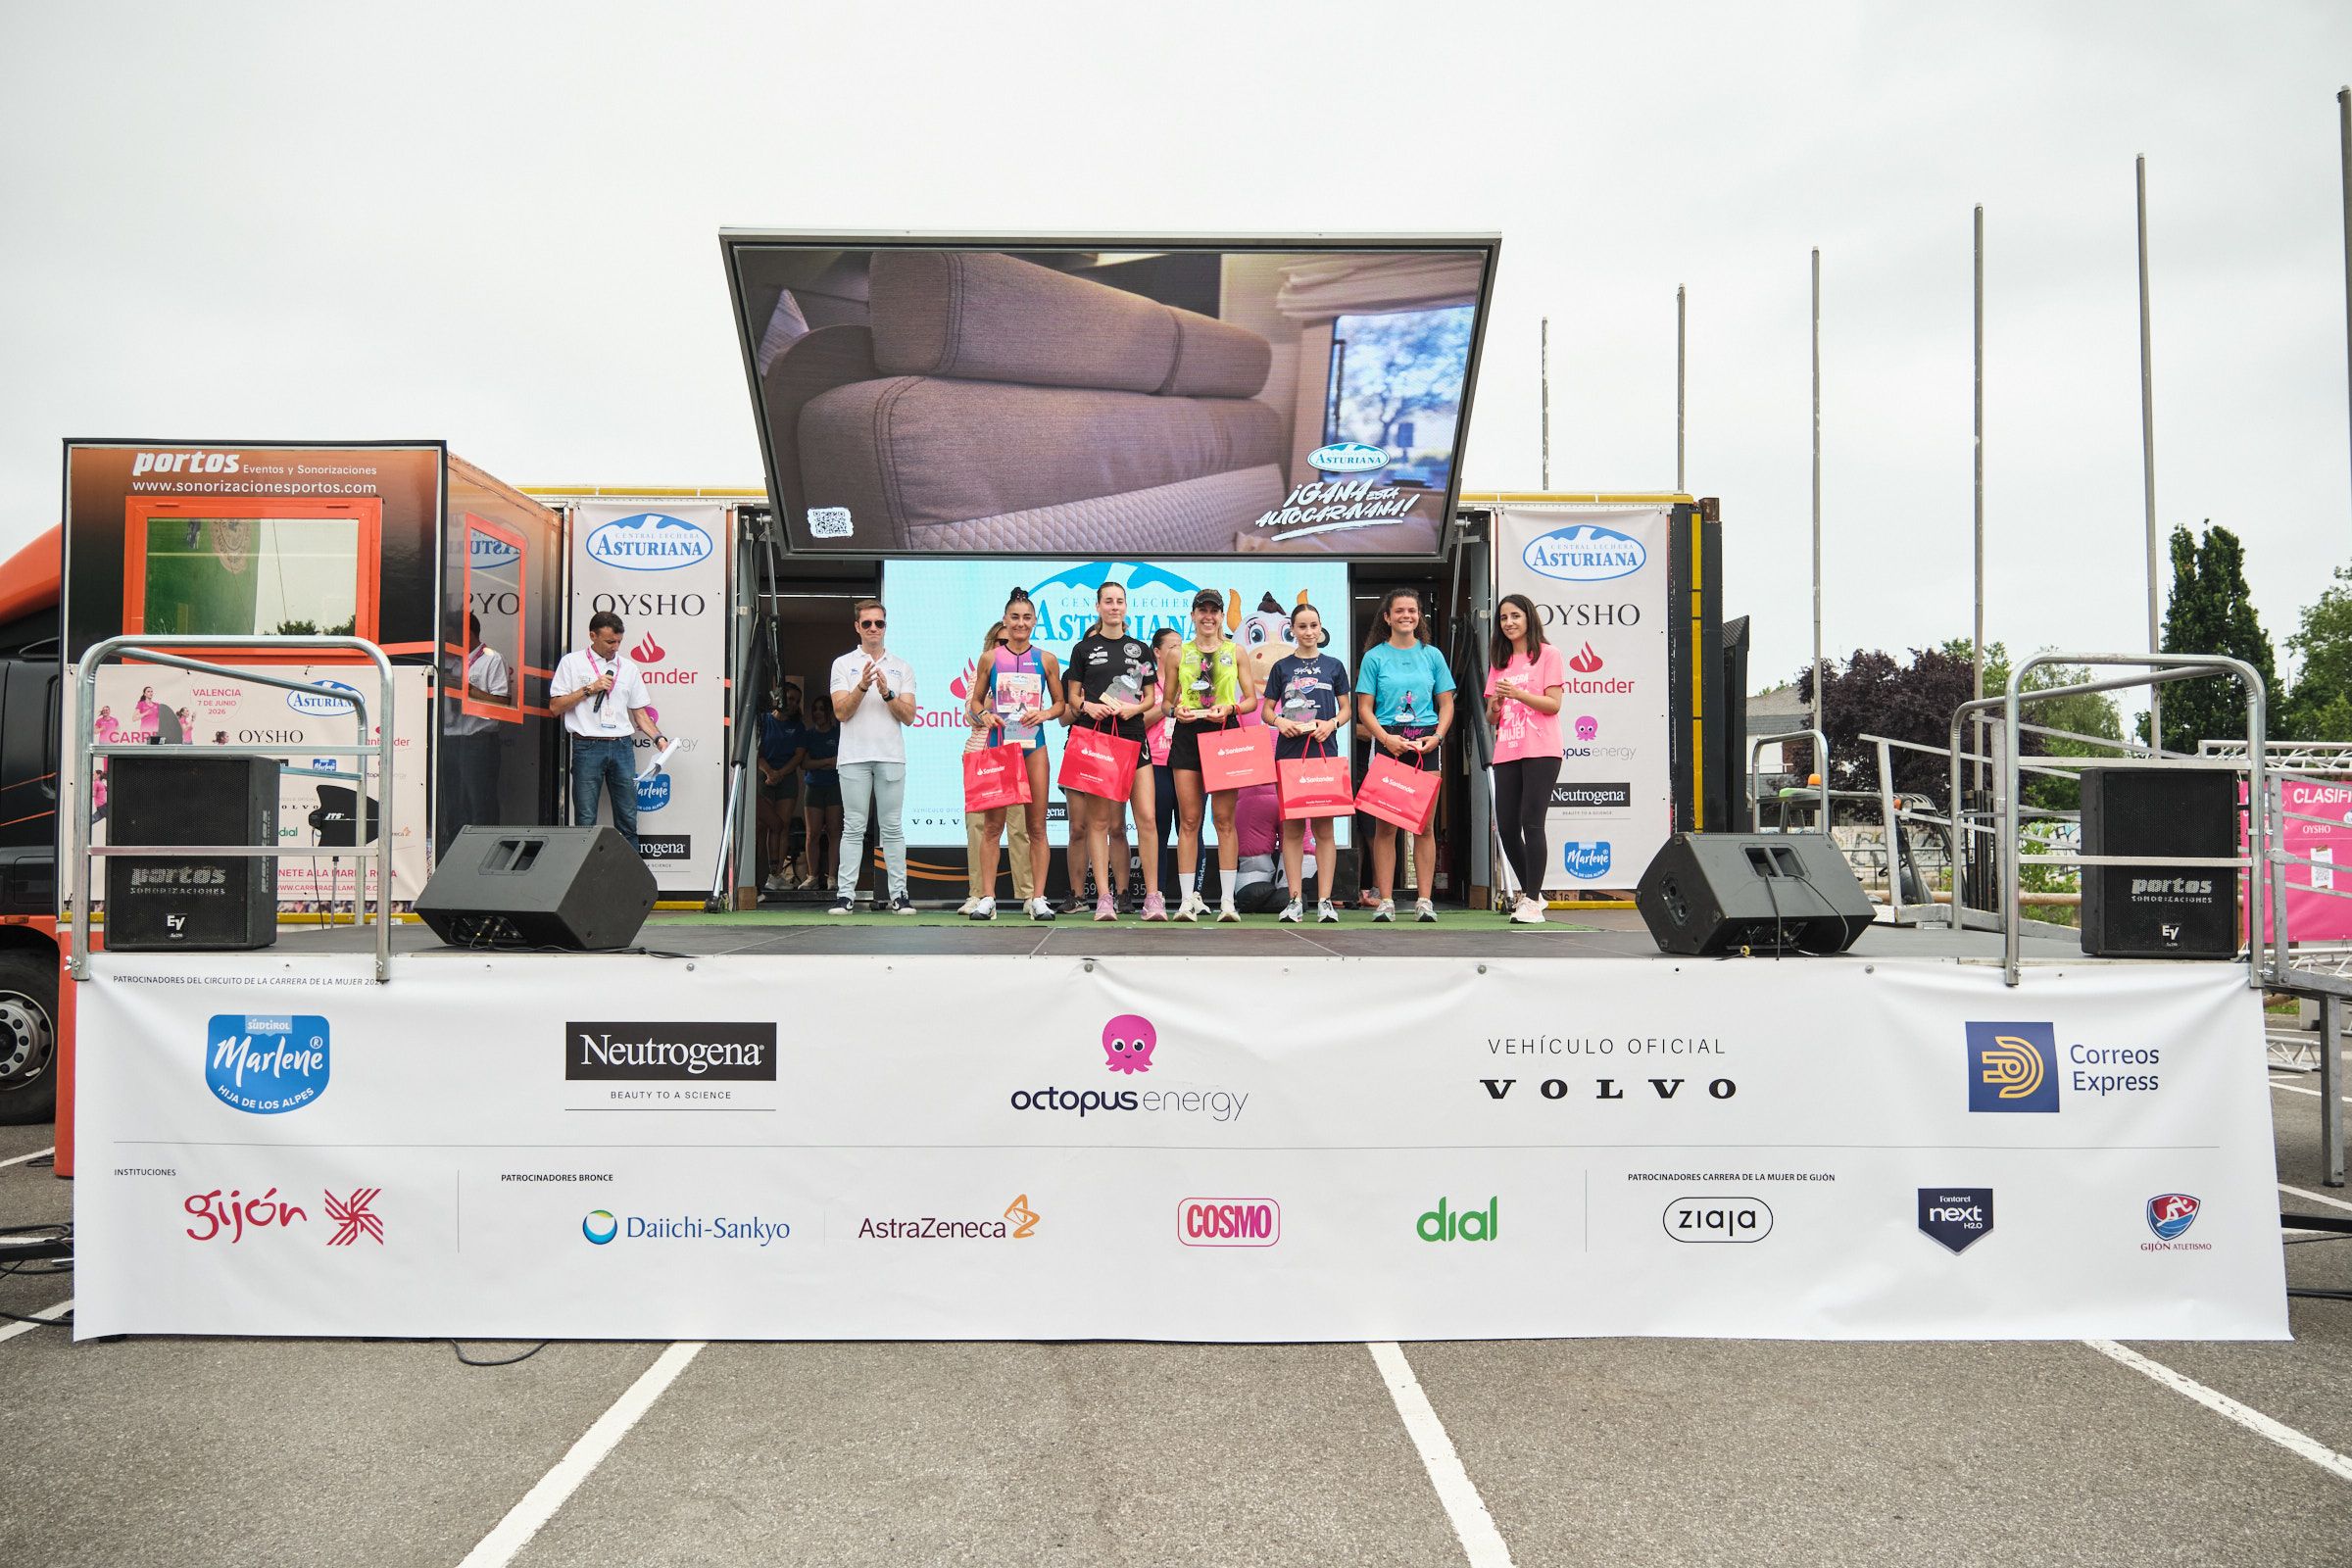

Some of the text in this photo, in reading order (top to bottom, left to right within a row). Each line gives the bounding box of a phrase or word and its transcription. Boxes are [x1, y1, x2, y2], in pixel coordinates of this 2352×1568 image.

[132, 451, 377, 476] portos Eventos y Sonorizaciones
[1315, 453, 1382, 465] ASTURIANA
[132, 480, 376, 495] www.sonorizacionesportos.com
[1255, 494, 1421, 528] AUTOCARAVANA!
[595, 534, 703, 557] ASTURIANA
[1533, 545, 1638, 566] ASTURIANA
[593, 593, 705, 616] OYSHO
[1133, 597, 1189, 607] LECHER
[1535, 604, 1641, 626] OYSHO
[192, 688, 242, 697] VALENCIA
[238, 729, 304, 744] OYSHO
[1087, 750, 1114, 762] Santander
[1225, 745, 1254, 755] Santander
[1592, 747, 1637, 760] energy
[982, 765, 1005, 775] Santander
[1388, 779, 1416, 794] Santander
[1550, 787, 1625, 805] Neutrogena
[2302, 825, 2331, 834] OYSHO
[1567, 850, 1608, 870] Marlene
[1198, 858, 1206, 891] adidas
[2132, 877, 2212, 894] portos
[167, 914, 186, 931] EV
[2162, 924, 2180, 941] EV
[113, 975, 185, 984] PATROCINADORES
[204, 976, 242, 985] CIRCUITO
[270, 977, 307, 986] CARRERA
[579, 1034, 762, 1074] Neutrogena
[1488, 1035, 1726, 1054] VEHÍCULO OFICIAL
[213, 1035, 323, 1088] Marlene
[2070, 1044, 2160, 1065] Correos
[1480, 1078, 1737, 1100] VOLVO
[2073, 1071, 2159, 1096] Express
[218, 1084, 315, 1109] HIJA DE LOS ALPES
[1010, 1086, 1250, 1121] octopus energy
[114, 1168, 176, 1177] INSTITUCIONES
[1767, 1173, 1794, 1182] MUJER
[1809, 1172, 1836, 1182] GIJÓN
[184, 1187, 307, 1244] gijón
[1187, 1204, 1272, 1239] COSMO
[1416, 1196, 1497, 1242] dial
[1929, 1204, 1983, 1221] next
[627, 1216, 790, 1247] Daiichi-Sankyo
[858, 1217, 1006, 1239] AstraZeneca
[1678, 1209, 1756, 1237] ziaja
[2140, 1241, 2171, 1251] GIJÓN
